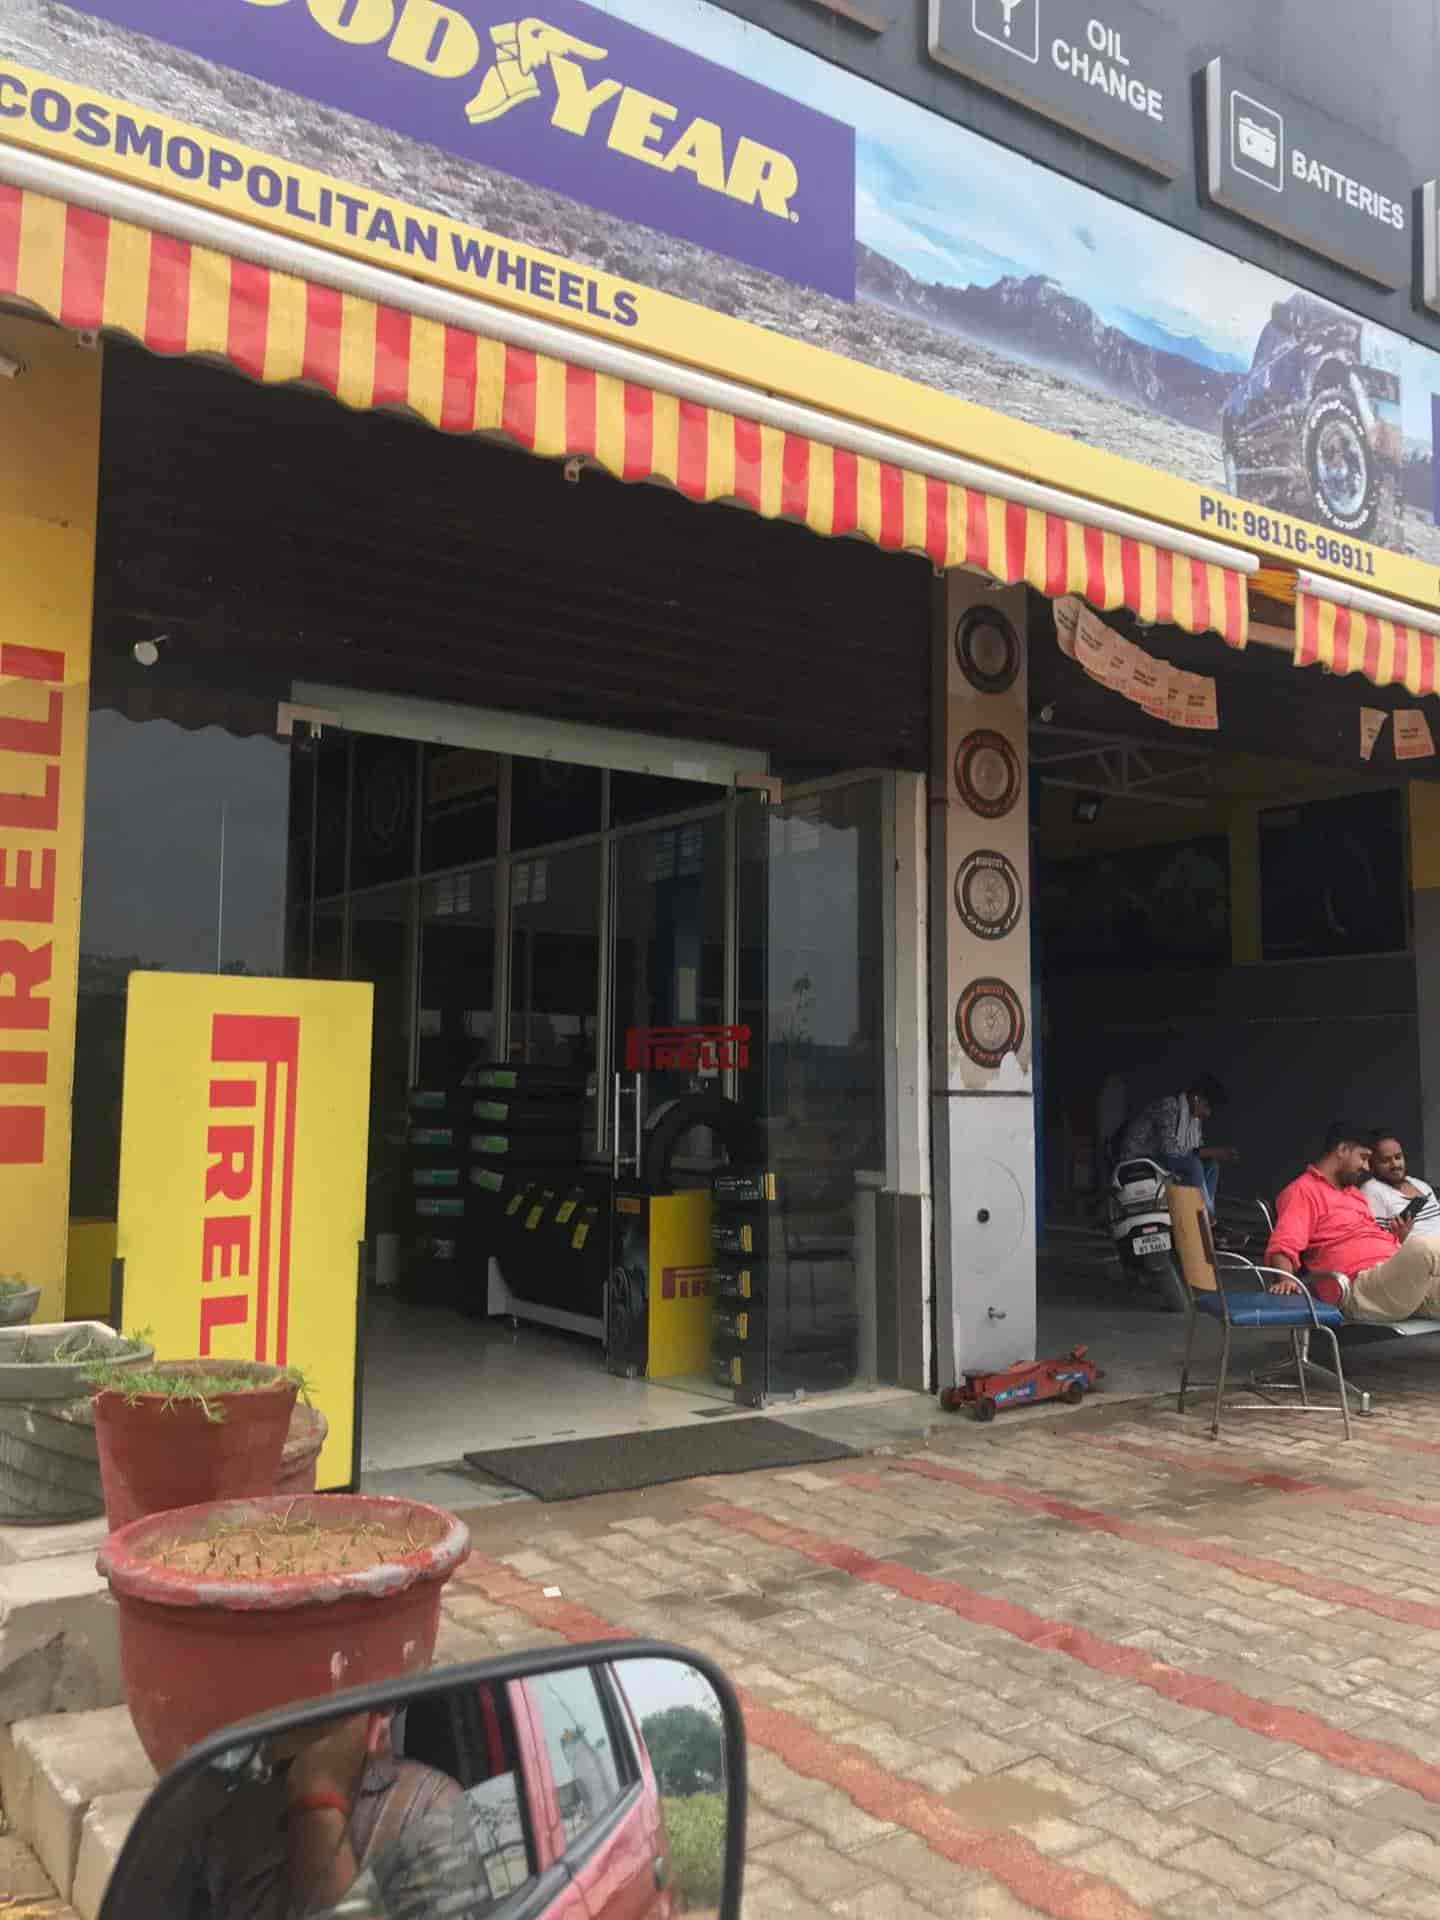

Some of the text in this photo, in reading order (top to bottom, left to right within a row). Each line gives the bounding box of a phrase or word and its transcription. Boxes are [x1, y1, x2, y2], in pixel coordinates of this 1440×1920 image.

[1051, 38, 1163, 121] CHANGE
[1087, 19, 1129, 65] OIL
[0, 73, 639, 328] COSMOPOLITAN WHEELS
[1292, 149, 1404, 230] BATTERIES
[1200, 495, 1238, 532] Ph:
[1243, 510, 1375, 576] 98116-96911
[624, 1024, 751, 1072] PIRELLI
